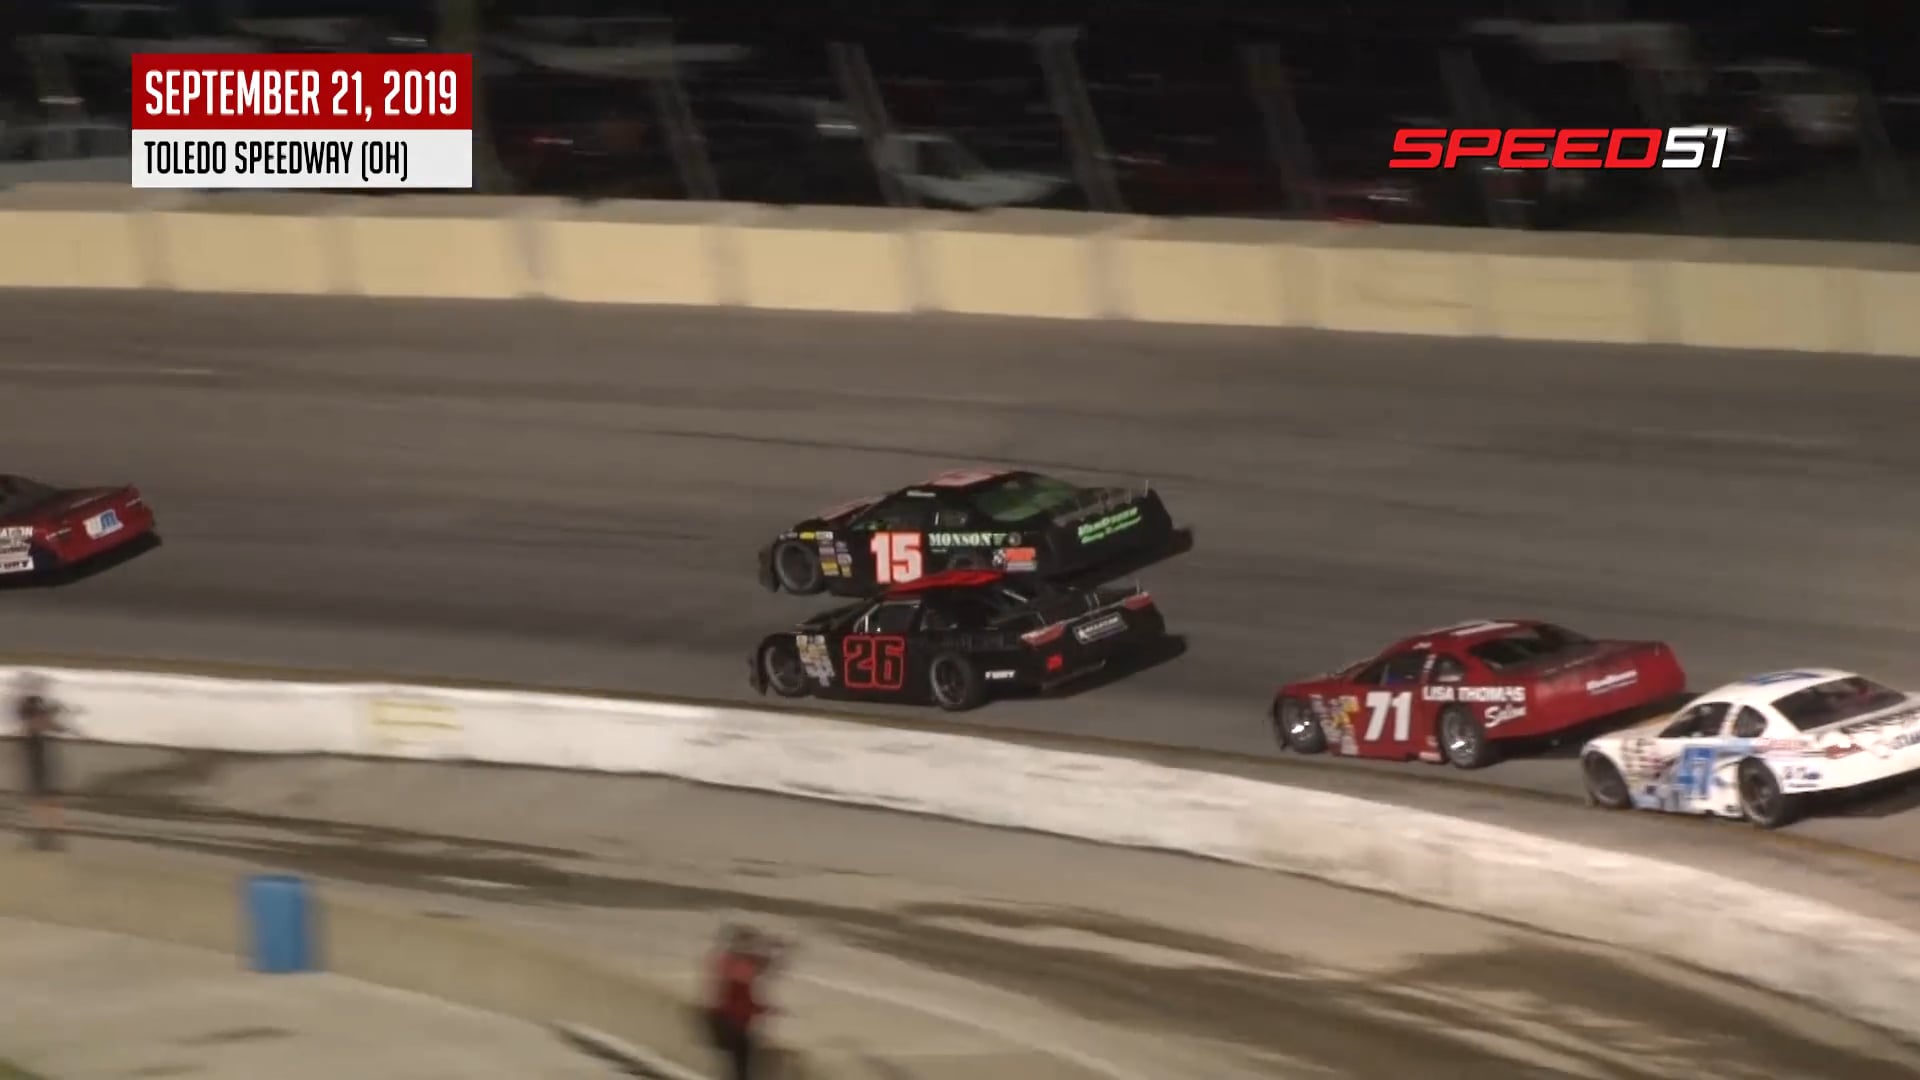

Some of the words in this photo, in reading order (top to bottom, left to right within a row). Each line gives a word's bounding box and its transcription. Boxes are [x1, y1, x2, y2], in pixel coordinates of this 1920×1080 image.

[870, 532, 922, 584] 15
[928, 532, 992, 546] MONSON
[843, 634, 905, 690] 26
[1364, 691, 1412, 740] 71
[1422, 686, 1454, 701] LISA
[1457, 686, 1526, 702] THOMAS
